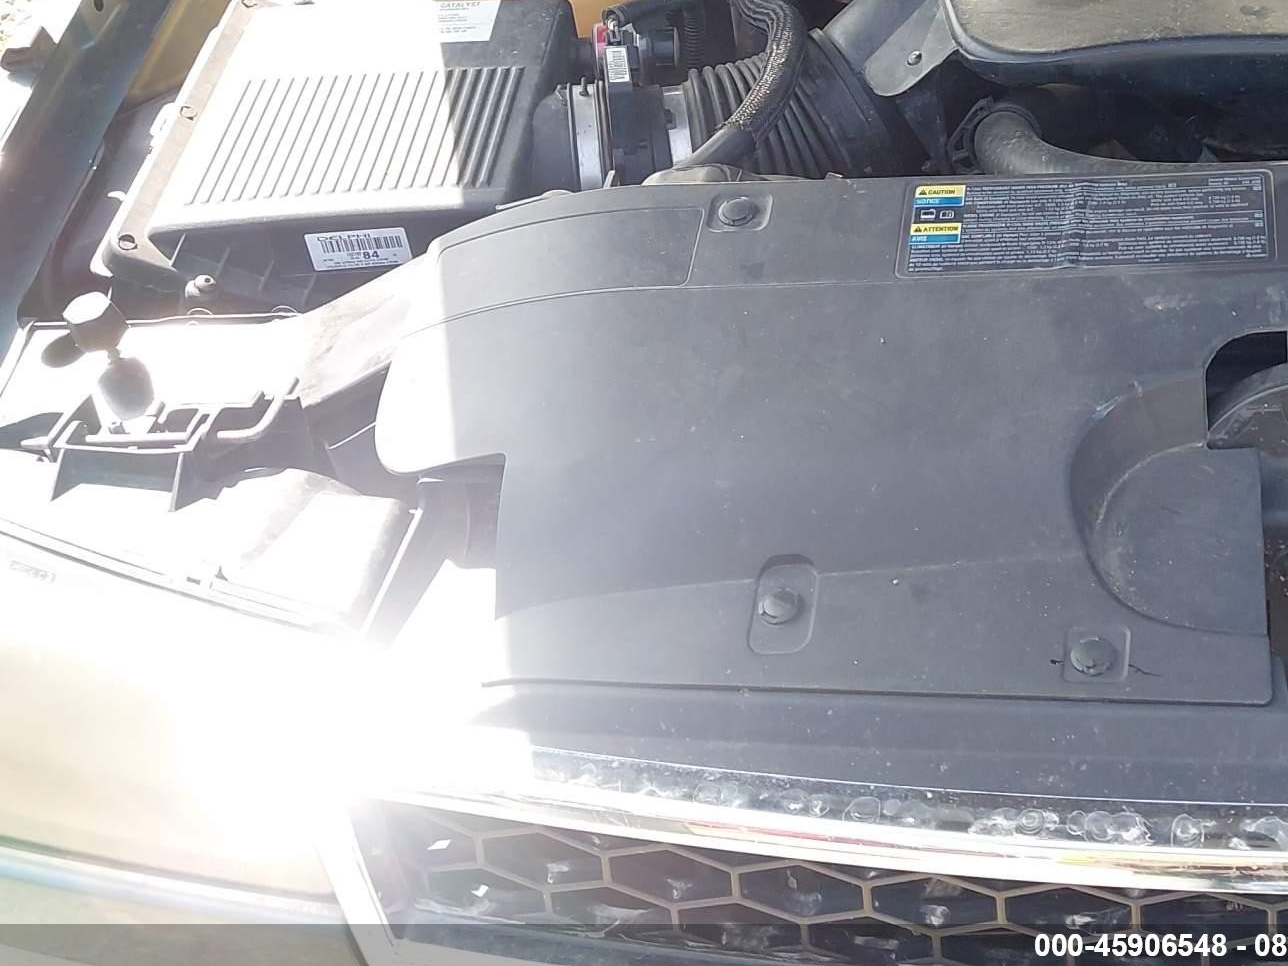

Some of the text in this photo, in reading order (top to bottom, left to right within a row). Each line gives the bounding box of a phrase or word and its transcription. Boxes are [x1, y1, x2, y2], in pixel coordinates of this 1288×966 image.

[439, 1, 481, 9] CATALYST
[922, 225, 959, 233] ATTENTION
[316, 233, 371, 242] DELPHI
[362, 250, 380, 260] 84
